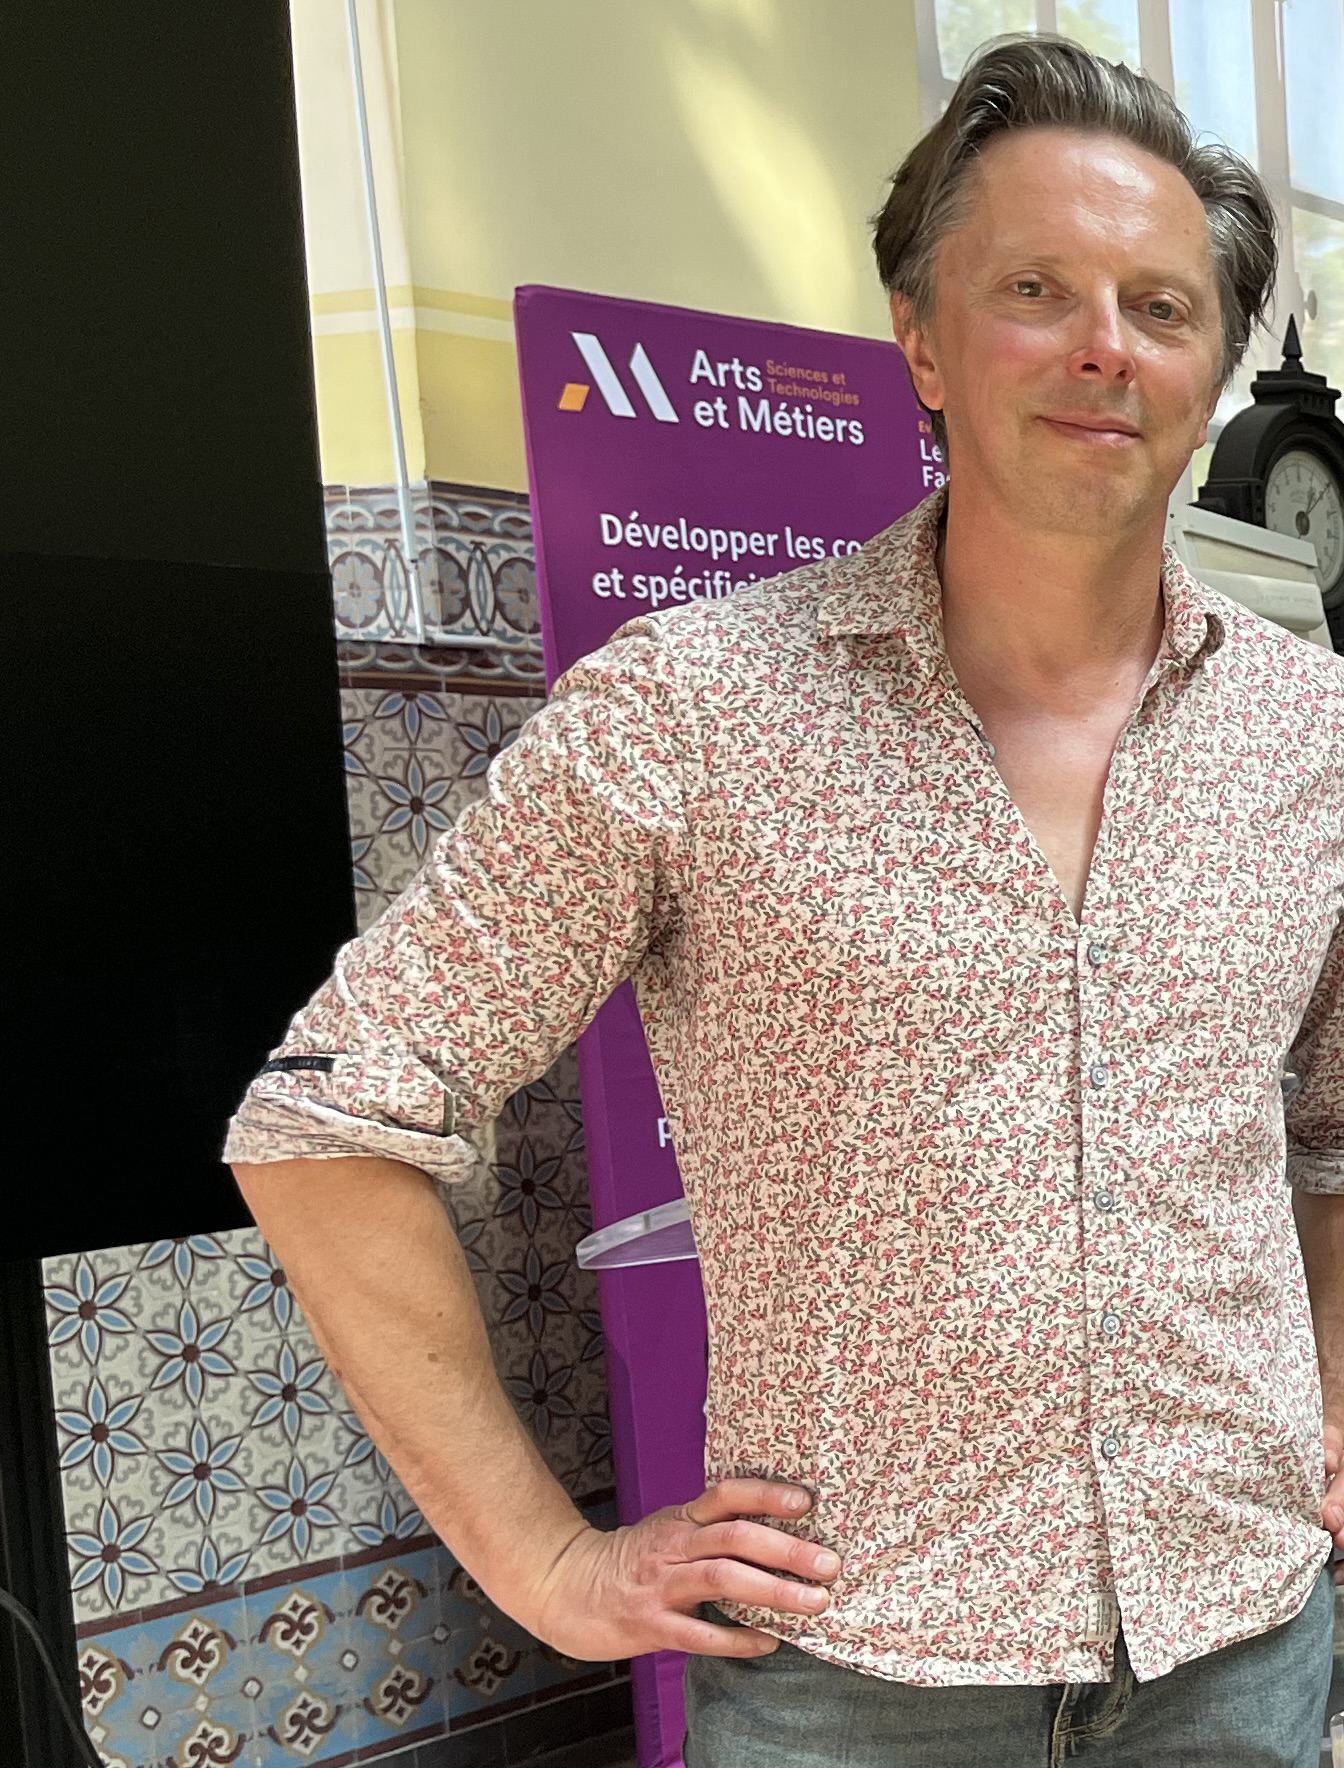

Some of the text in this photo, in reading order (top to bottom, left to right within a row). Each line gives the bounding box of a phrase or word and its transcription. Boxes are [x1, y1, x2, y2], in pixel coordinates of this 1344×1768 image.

[690, 349, 763, 392] Arts
[766, 359, 846, 386] Sciences et
[768, 379, 860, 407] Technologies
[694, 396, 865, 445] et Métiers
[600, 511, 779, 562] Développer
[785, 526, 826, 560] les
[592, 567, 626, 598] et
